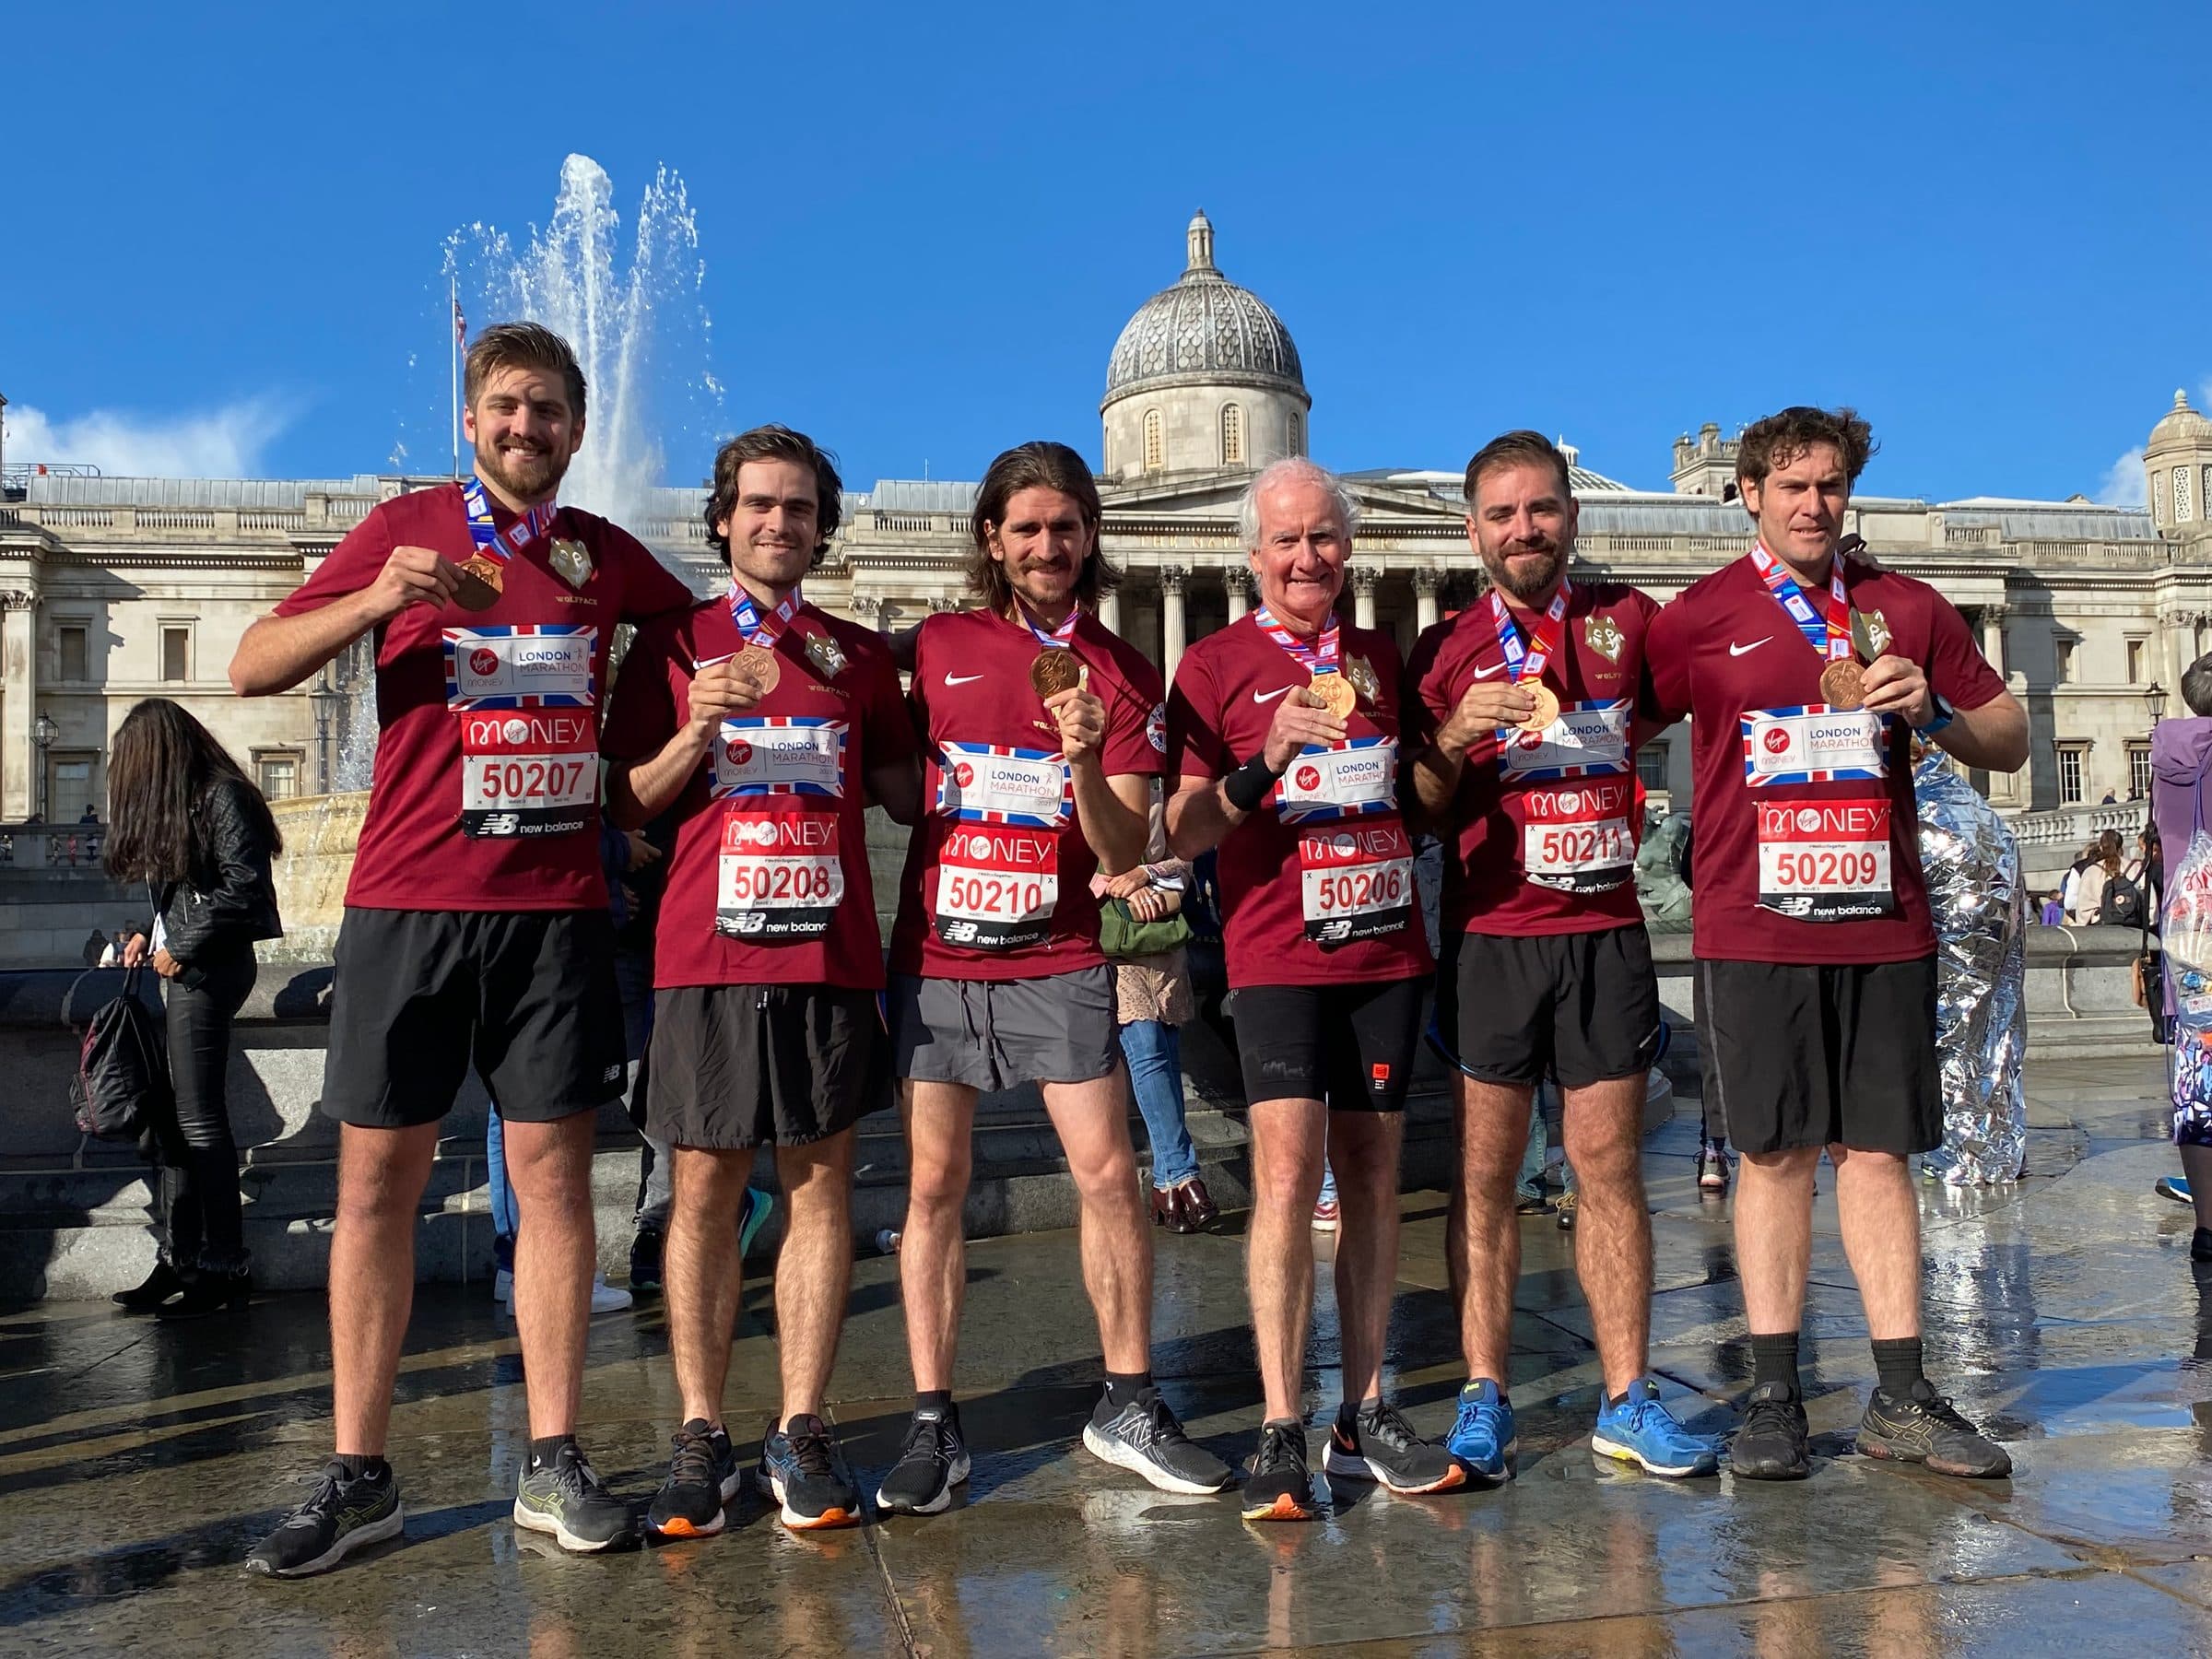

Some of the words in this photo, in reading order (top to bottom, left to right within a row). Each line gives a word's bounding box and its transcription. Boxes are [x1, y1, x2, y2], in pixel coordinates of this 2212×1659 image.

[519, 651, 571, 662] LONDON
[520, 663, 584, 673] MARATHON
[1562, 724, 1609, 735] LONDON
[1809, 727, 1861, 739] LONDON
[771, 742, 819, 752] LONDON
[1562, 735, 1620, 747] MARATHON
[773, 753, 834, 764] MARATHON
[1336, 761, 1379, 774] LONDON
[482, 761, 583, 798] 50207
[992, 771, 1040, 783] LONDON
[990, 782, 1055, 797] MARATHON
[520, 824, 542, 834] new
[545, 819, 584, 833] balance
[1542, 826, 1622, 864] 50211
[1777, 852, 1877, 886] 50209
[735, 865, 830, 900] 50208
[949, 876, 1042, 915] 50210
[1319, 869, 1401, 911] 50206
[1813, 907, 1836, 916] new
[1837, 905, 1882, 915] balance
[766, 923, 789, 933] new
[1352, 927, 1372, 937] new
[1373, 923, 1404, 935] balance
[977, 935, 998, 946] new
[1000, 932, 1039, 946] balance
